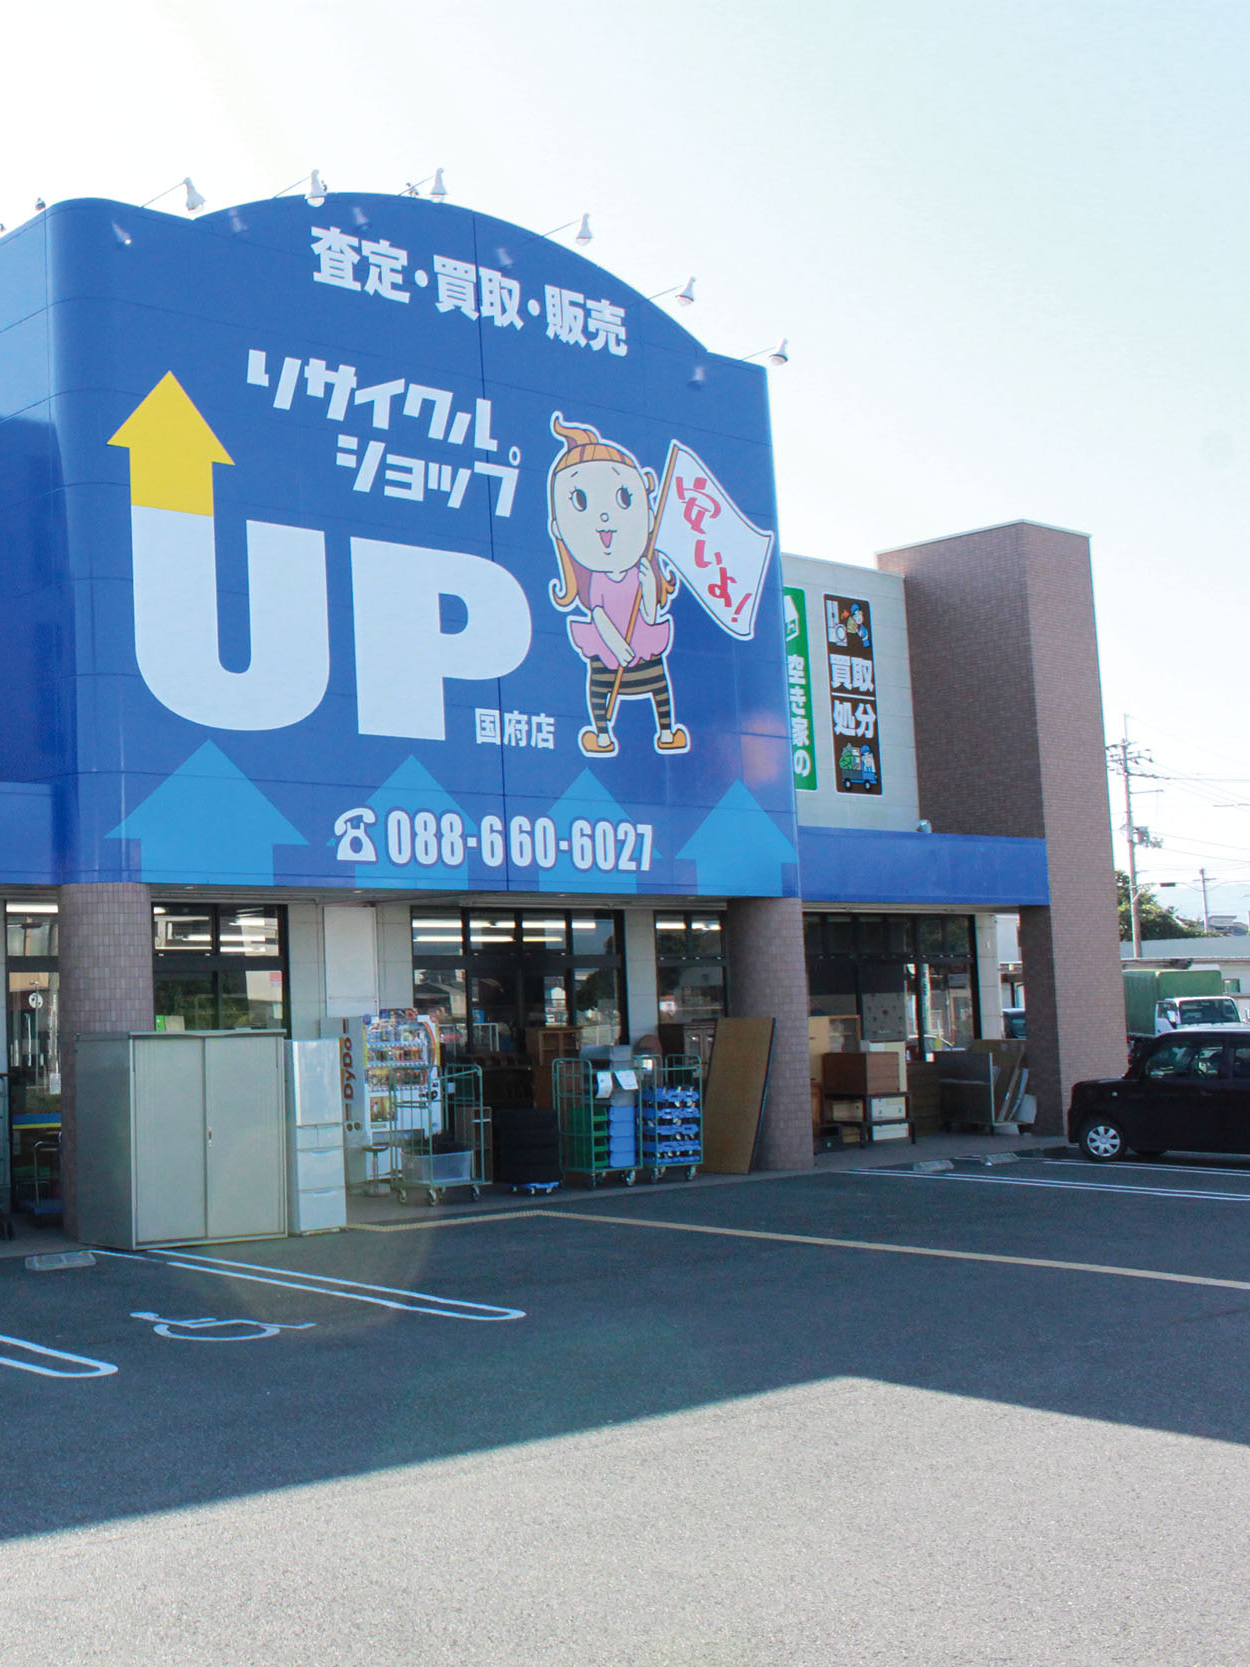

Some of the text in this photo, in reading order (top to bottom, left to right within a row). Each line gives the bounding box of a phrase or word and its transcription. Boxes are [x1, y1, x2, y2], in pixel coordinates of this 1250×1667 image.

[311, 226, 628, 356] 査定・買取・販売
[246, 349, 498, 449] リサイクル
[336, 434, 521, 518] ショップ
[131, 505, 532, 741] UP
[829, 653, 874, 692] 買取
[475, 708, 555, 749] 国府店
[833, 700, 876, 738] 処分
[387, 810, 652, 871] 088-660-6027
